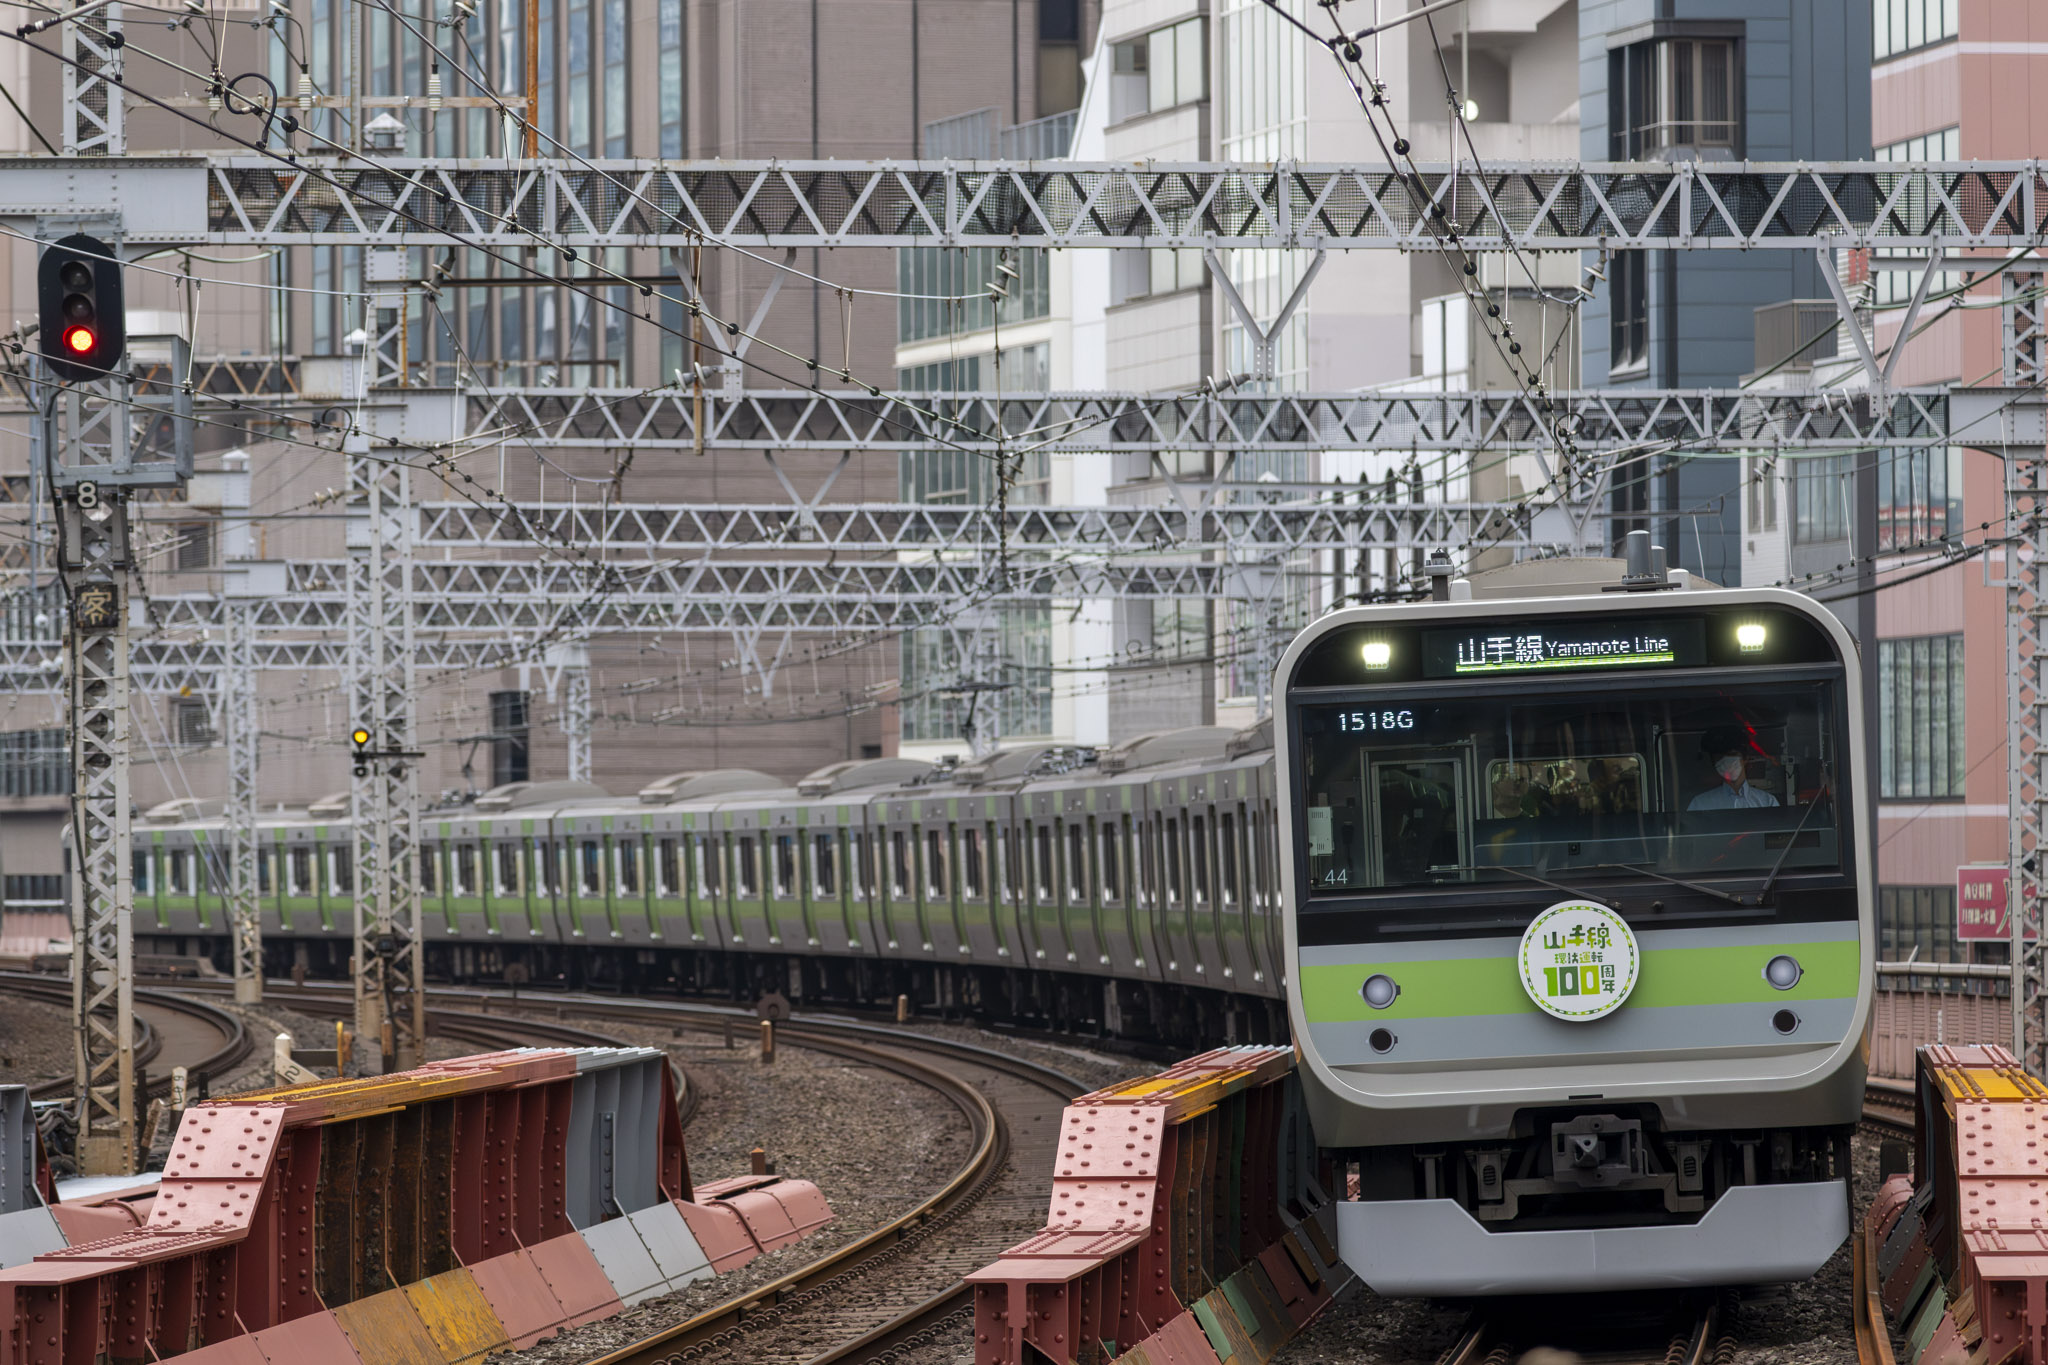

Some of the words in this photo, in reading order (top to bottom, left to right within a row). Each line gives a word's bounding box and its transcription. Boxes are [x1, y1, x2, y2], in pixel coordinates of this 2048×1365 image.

[77, 481, 97, 509] 8
[80, 587, 113, 626] 客
[1458, 635, 1545, 665] 山手線
[1545, 640, 1630, 657] Yamanote
[1635, 636, 1669, 653] Line
[1338, 710, 1414, 731] 1518G
[1324, 868, 1348, 885] 44
[1543, 922, 1613, 949] 山手線
[1543, 965, 1601, 997] 100
[1601, 964, 1616, 994] 周年
